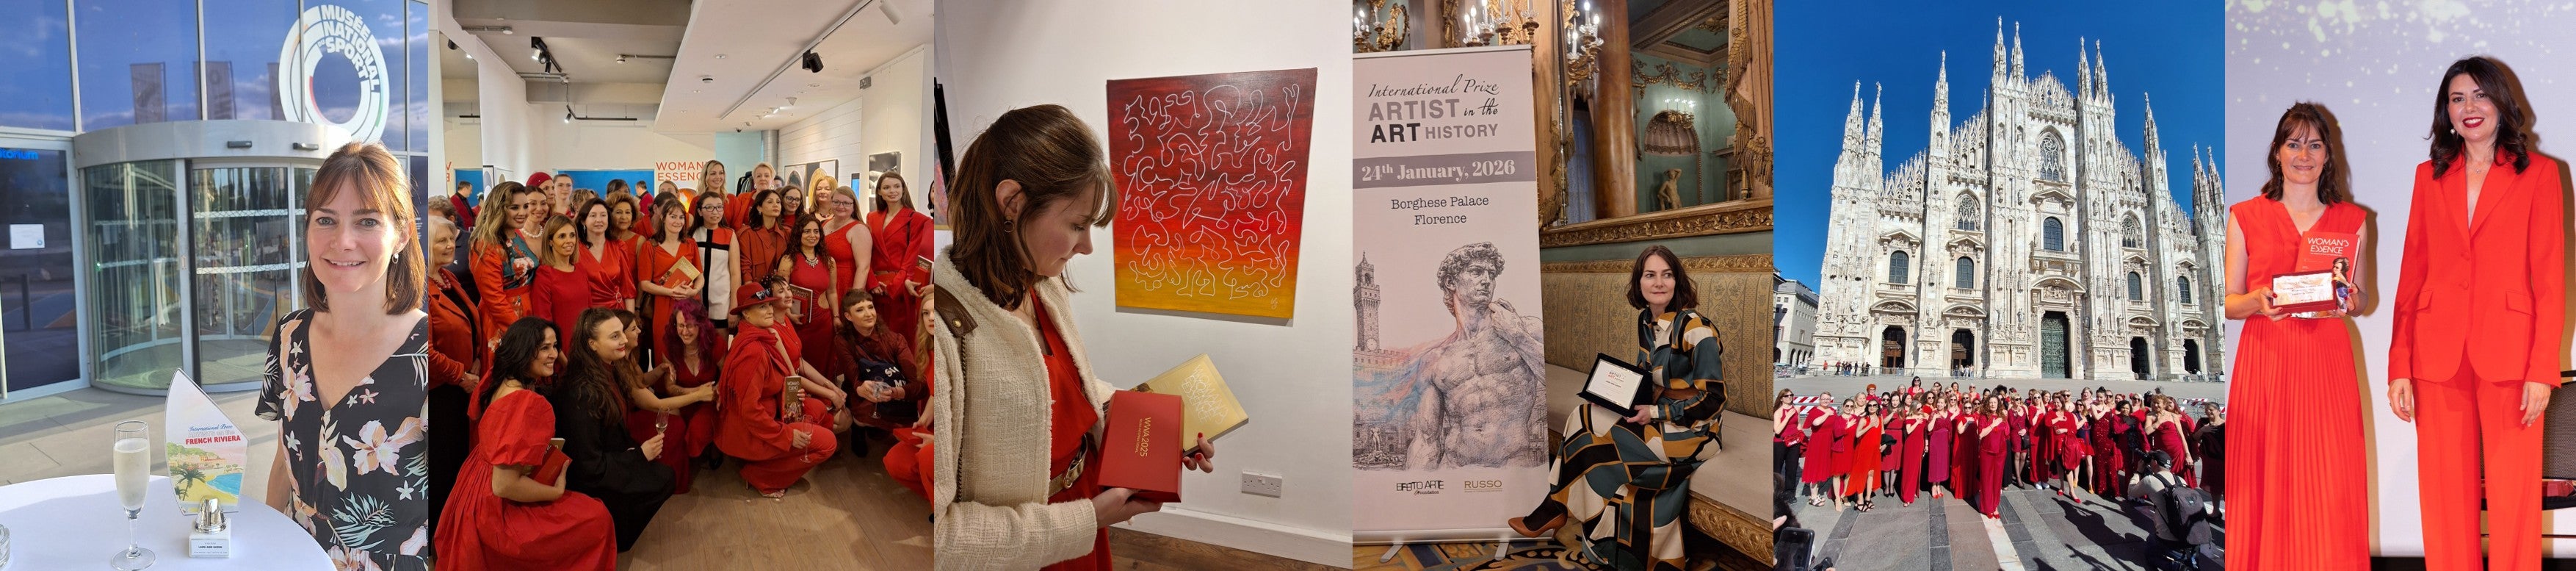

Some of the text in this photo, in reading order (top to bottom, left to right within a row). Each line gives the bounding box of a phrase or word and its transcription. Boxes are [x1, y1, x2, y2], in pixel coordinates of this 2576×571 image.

[321, 4, 371, 41] MUSÉE
[323, 21, 380, 90] NATIONAL
[325, 37, 369, 79] SPORT
[1368, 73, 1499, 98] International Prize
[1368, 98, 1499, 121] ARTIST in the
[1370, 122, 1498, 143] ART HISTORY
[656, 161, 707, 170] WOMAN'
[1361, 159, 1516, 182] 24th January, 2026
[658, 173, 702, 182] ESSENC
[1391, 195, 1489, 211] Borghese Palace
[1414, 215, 1467, 225] Florence
[2307, 237, 2349, 247] WOMAN'S
[2310, 245, 2343, 254] ESSENCE
[188, 424, 219, 432] International
[1143, 417, 1151, 437] WWA
[214, 435, 241, 443] RIVIERA
[1140, 438, 1149, 456] 2025
[1425, 480, 1444, 489] ARTE
[1464, 480, 1502, 489] RUSSO
